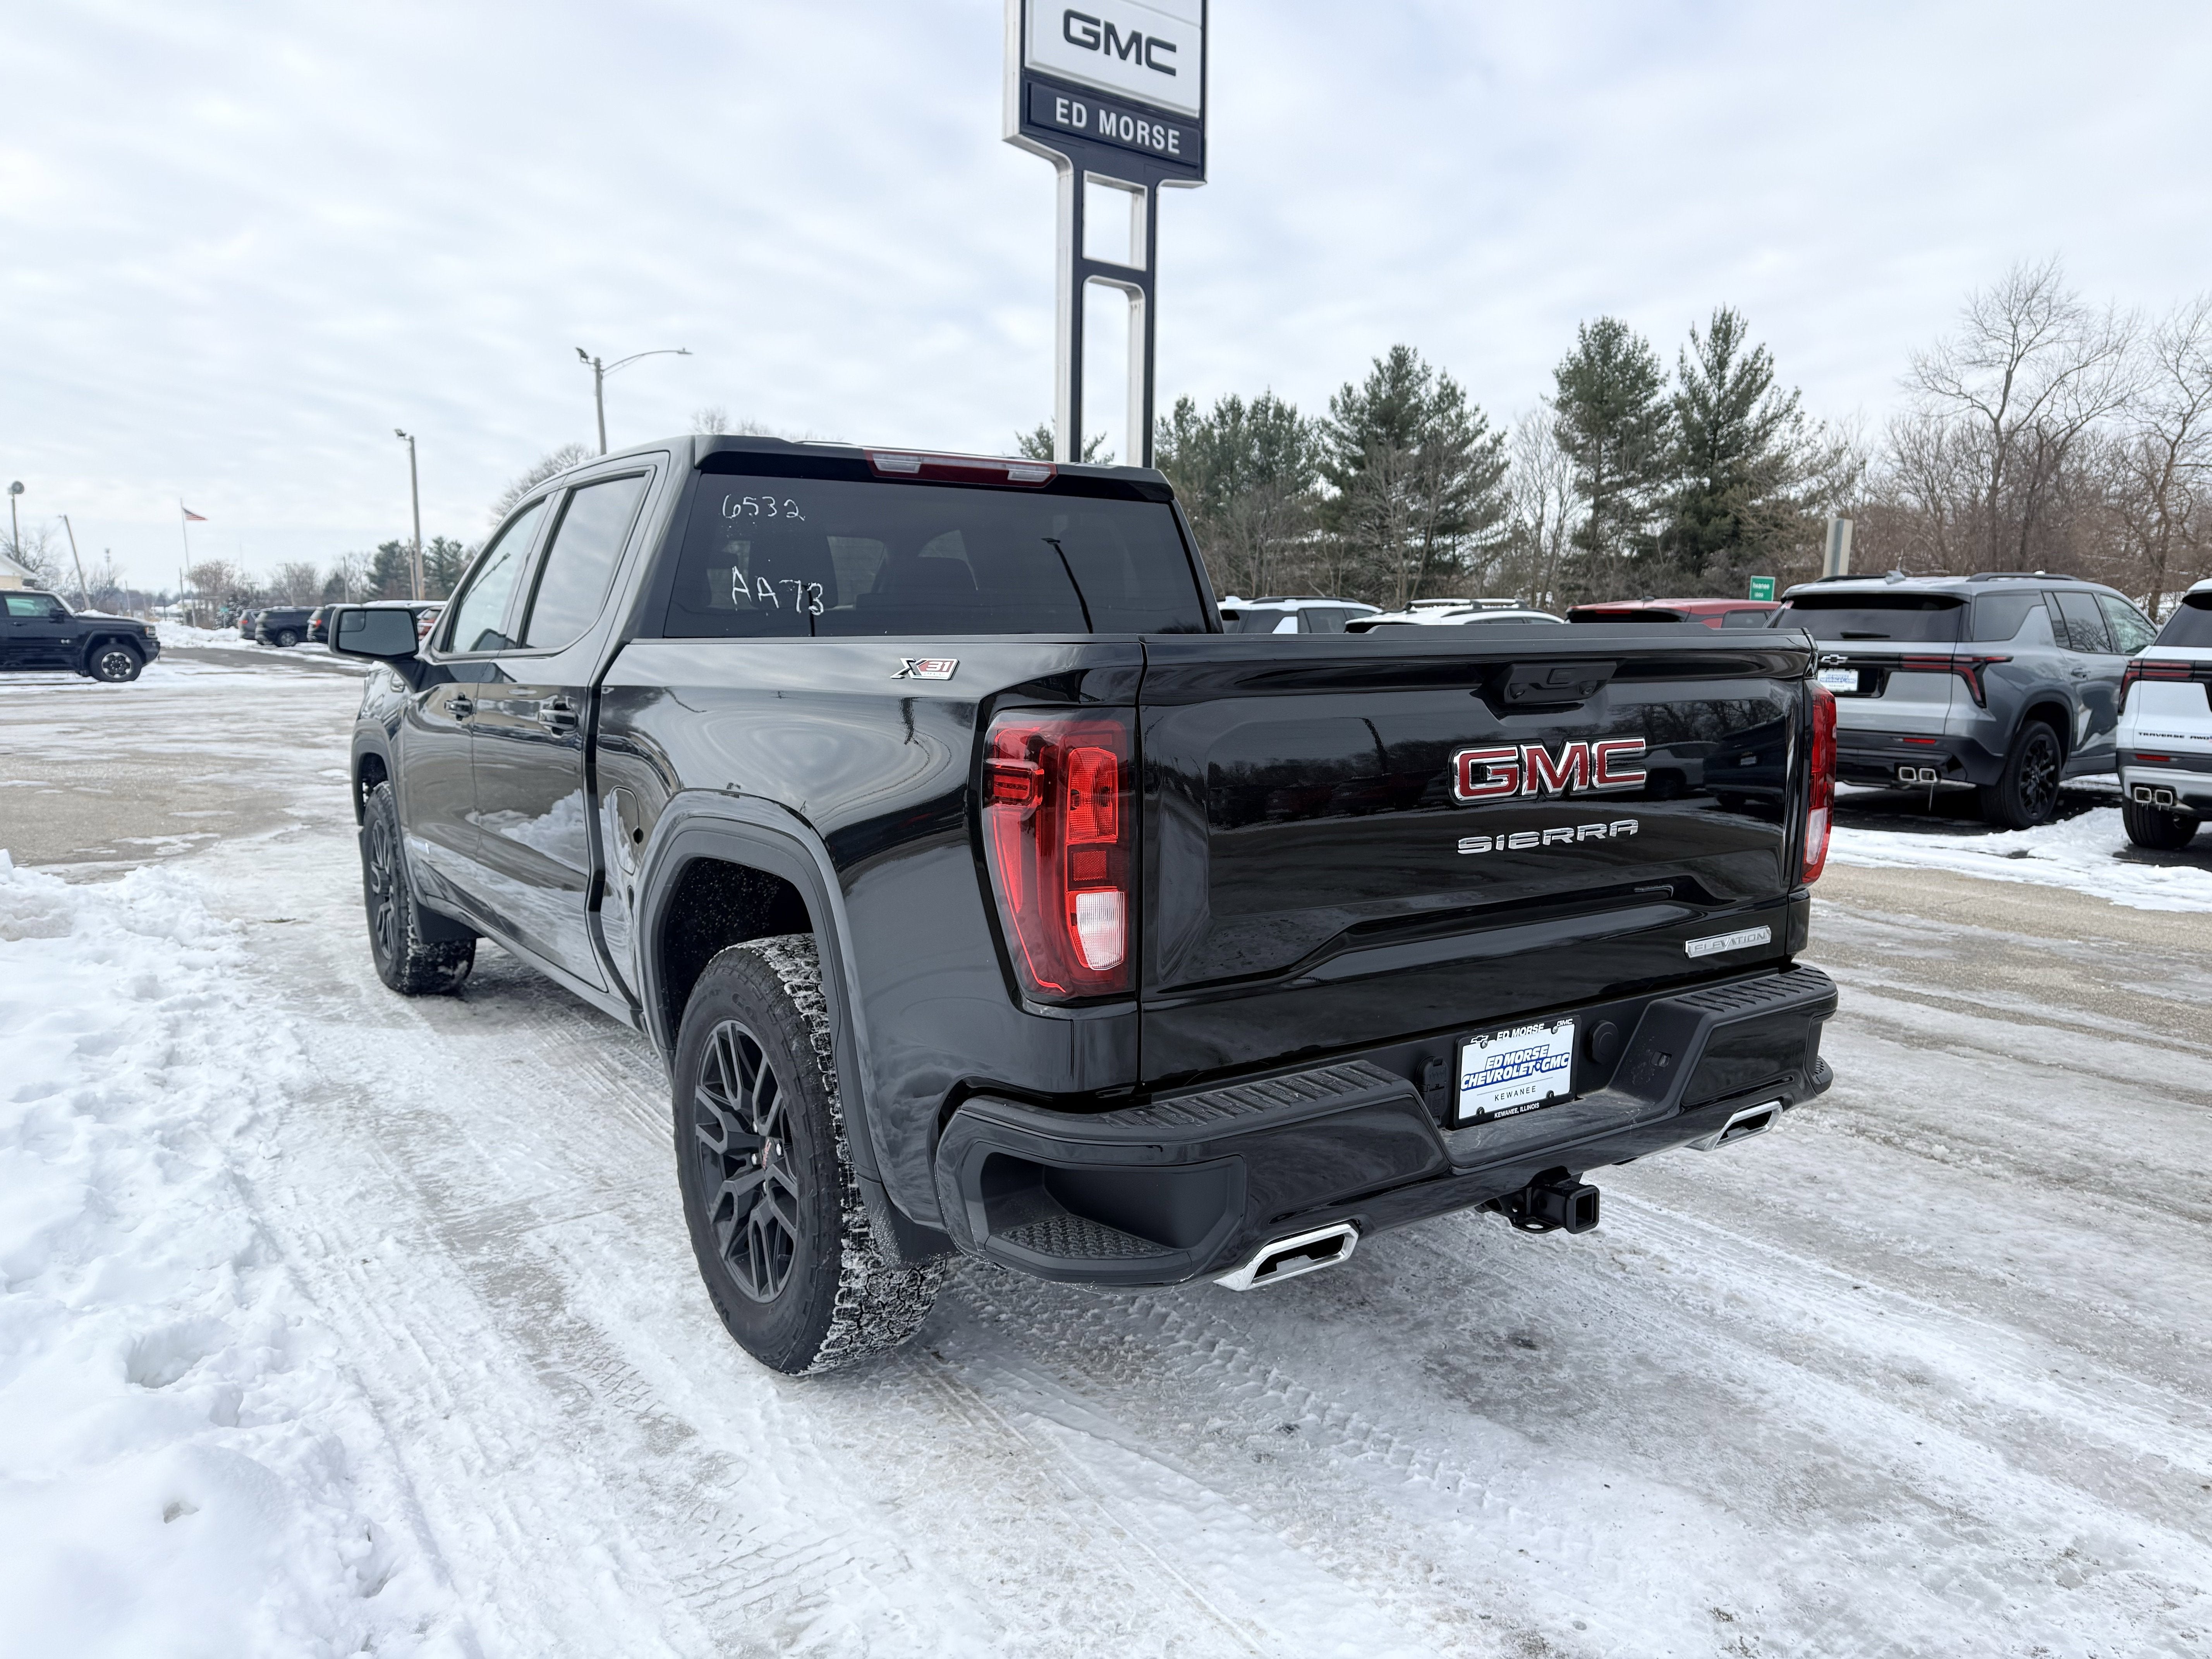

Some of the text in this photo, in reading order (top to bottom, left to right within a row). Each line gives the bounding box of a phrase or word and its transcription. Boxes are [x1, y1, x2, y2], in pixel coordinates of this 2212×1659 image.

[1063, 9, 1176, 77] GMC
[1056, 96, 1180, 155] ED MORSE
[722, 494, 805, 521] 6532
[1453, 737, 1647, 801] GMC
[1457, 819, 1639, 855] SIERRA
[1694, 931, 1766, 952] ELEVATION
[1496, 1018, 1573, 1041] ED MORSE GMC
[1485, 1044, 1550, 1071] ED MORSE
[1494, 1085, 1537, 1101] KEWANEE
[1494, 1102, 1540, 1119] KEWANEE, ILLINOIS
